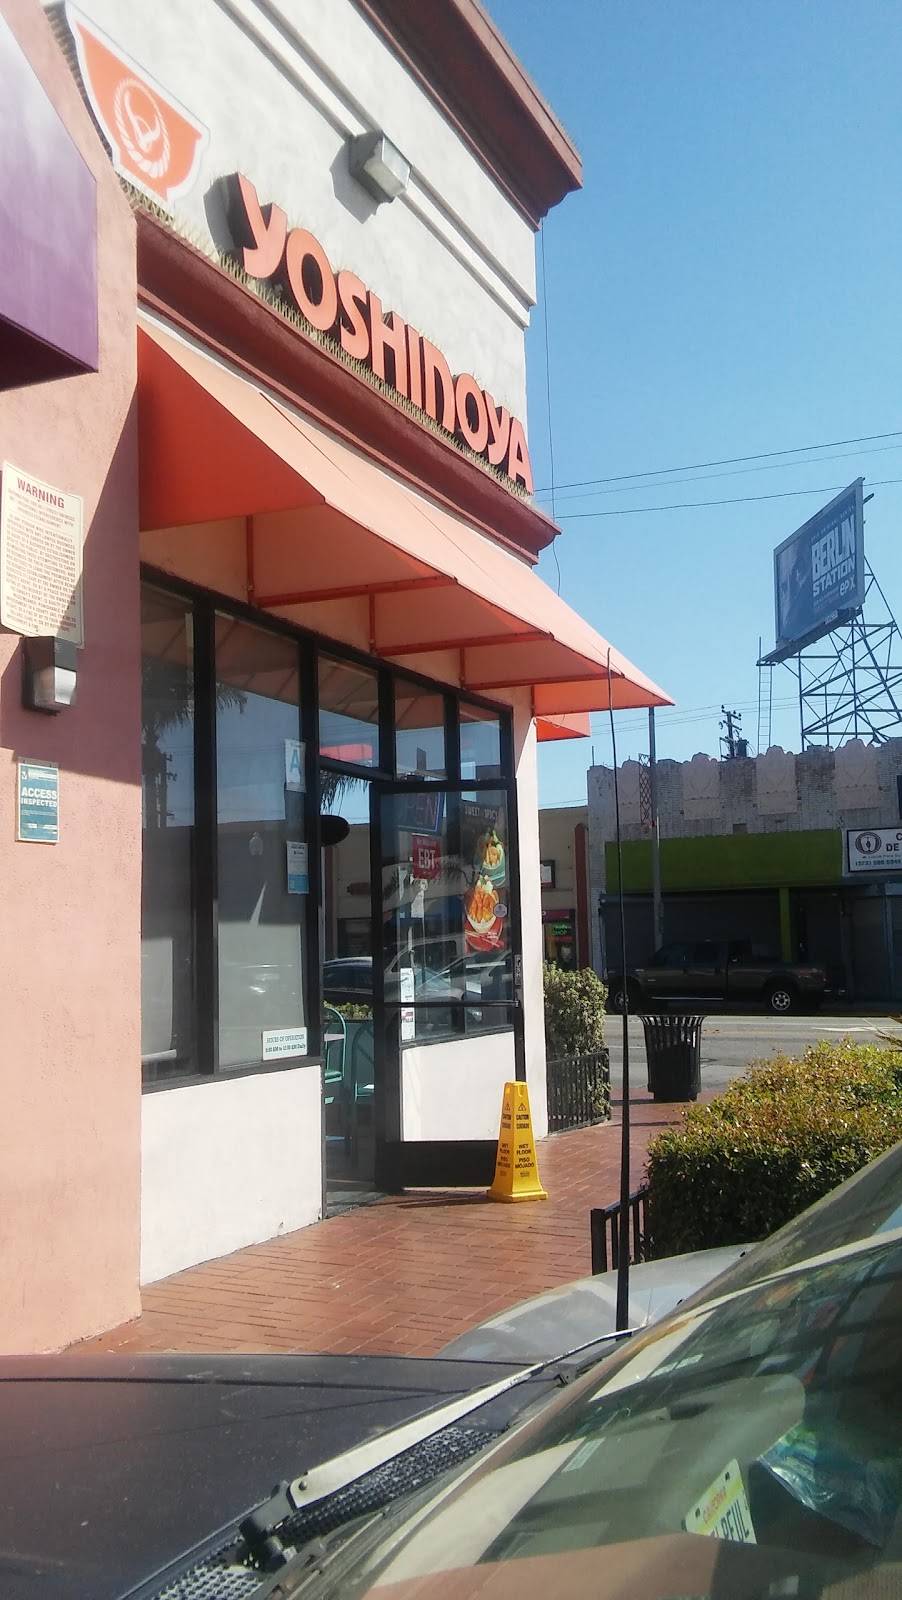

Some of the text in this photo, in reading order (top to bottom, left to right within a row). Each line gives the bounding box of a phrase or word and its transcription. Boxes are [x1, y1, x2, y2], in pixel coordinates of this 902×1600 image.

[237, 171, 534, 496] YOSHINOYA
[17, 477, 65, 509] WARNING
[811, 513, 856, 582] BERLIN
[812, 555, 856, 597] STATION
[290, 749, 301, 774] A
[21, 786, 57, 800] ACCESS
[21, 797, 57, 808] INSPECTED
[418, 848, 436, 870] EBT
